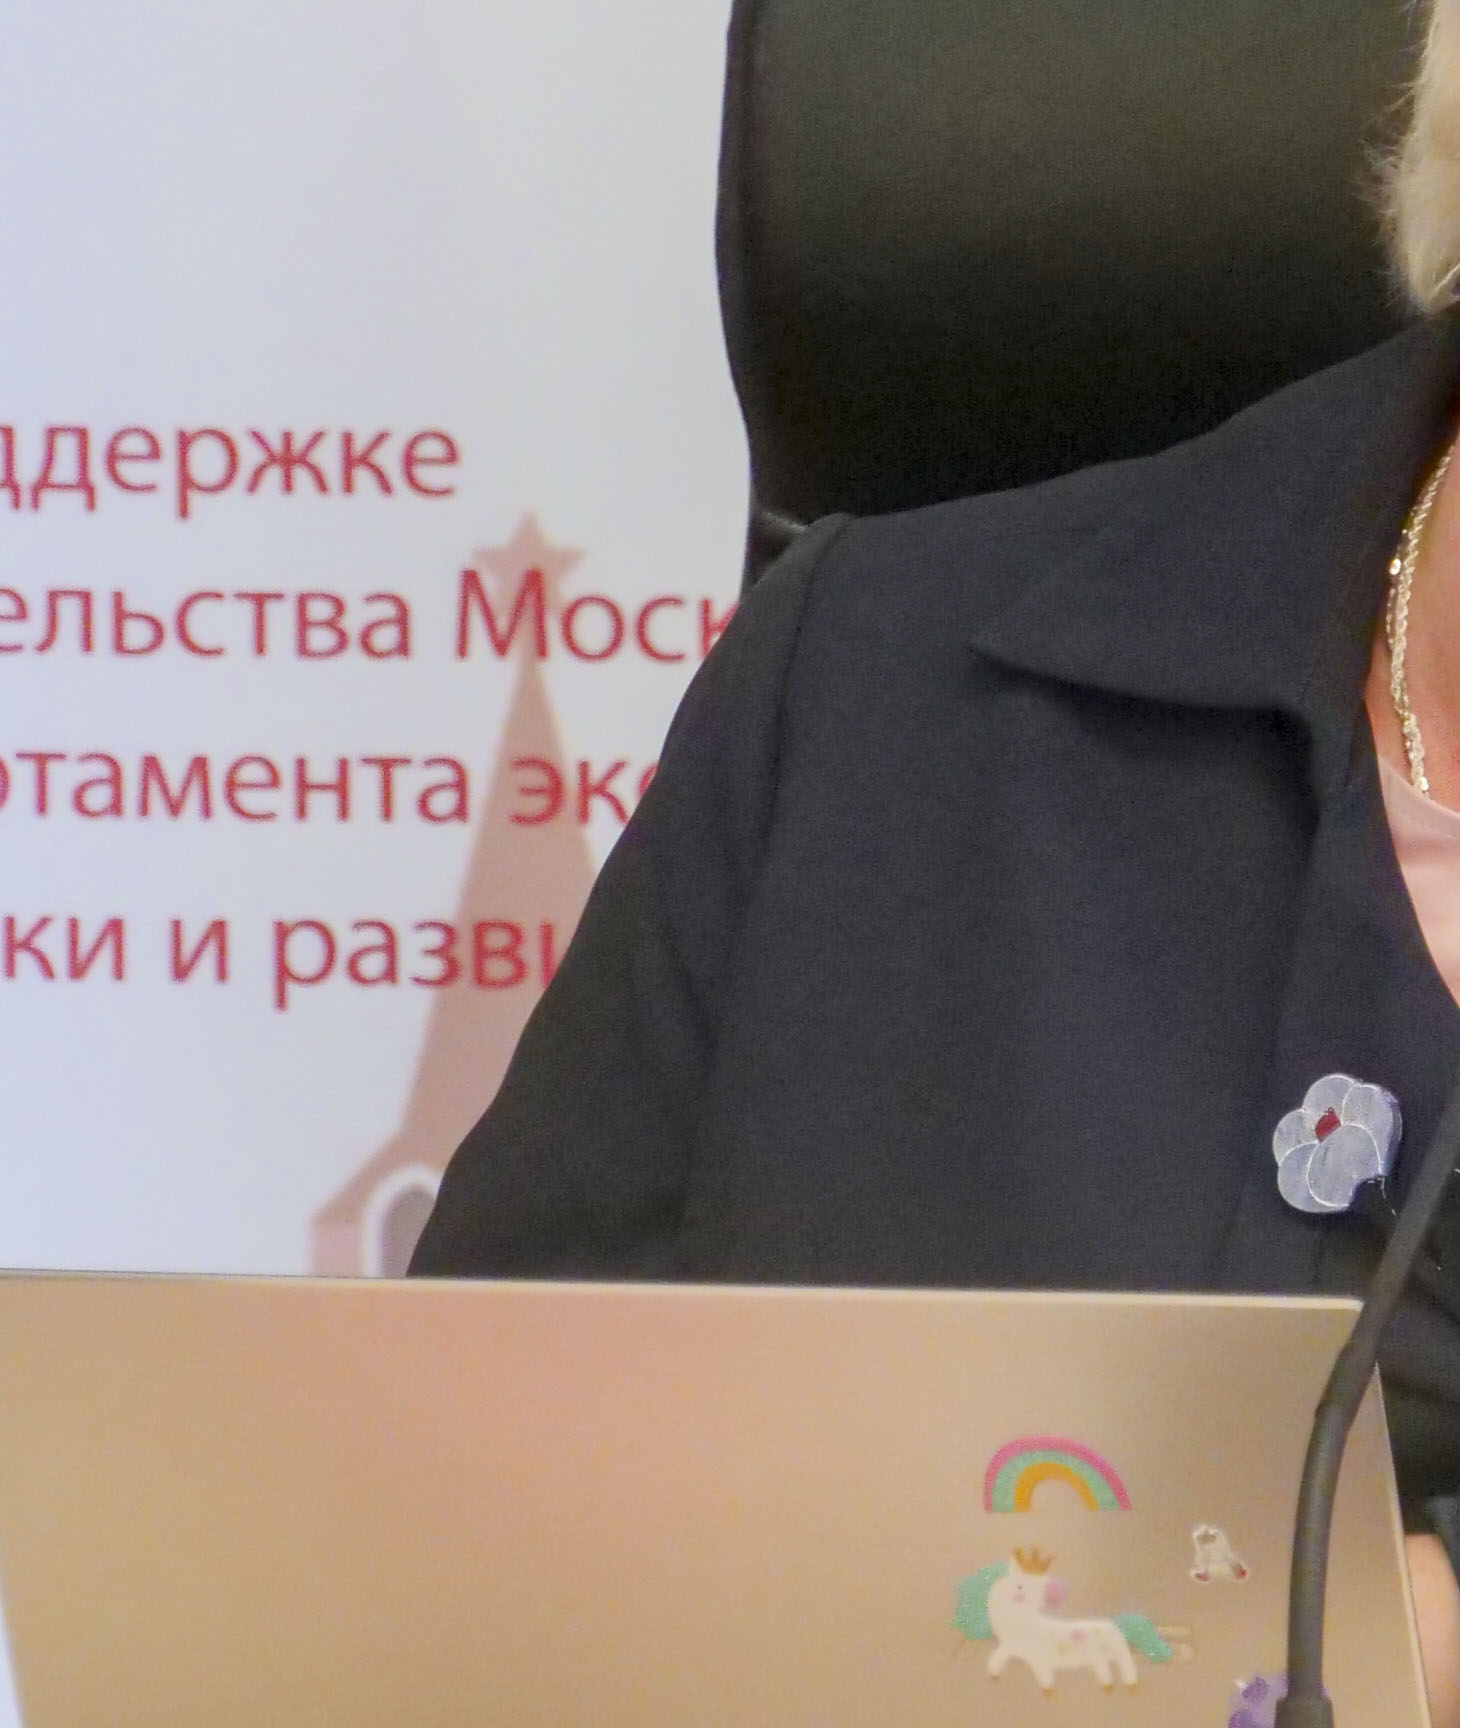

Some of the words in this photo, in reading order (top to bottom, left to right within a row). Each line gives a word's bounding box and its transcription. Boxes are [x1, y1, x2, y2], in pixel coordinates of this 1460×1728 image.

[0, 751, 469, 823] тамента
[507, 752, 660, 828] эк
[3, 916, 125, 980] ки
[171, 919, 229, 982] и
